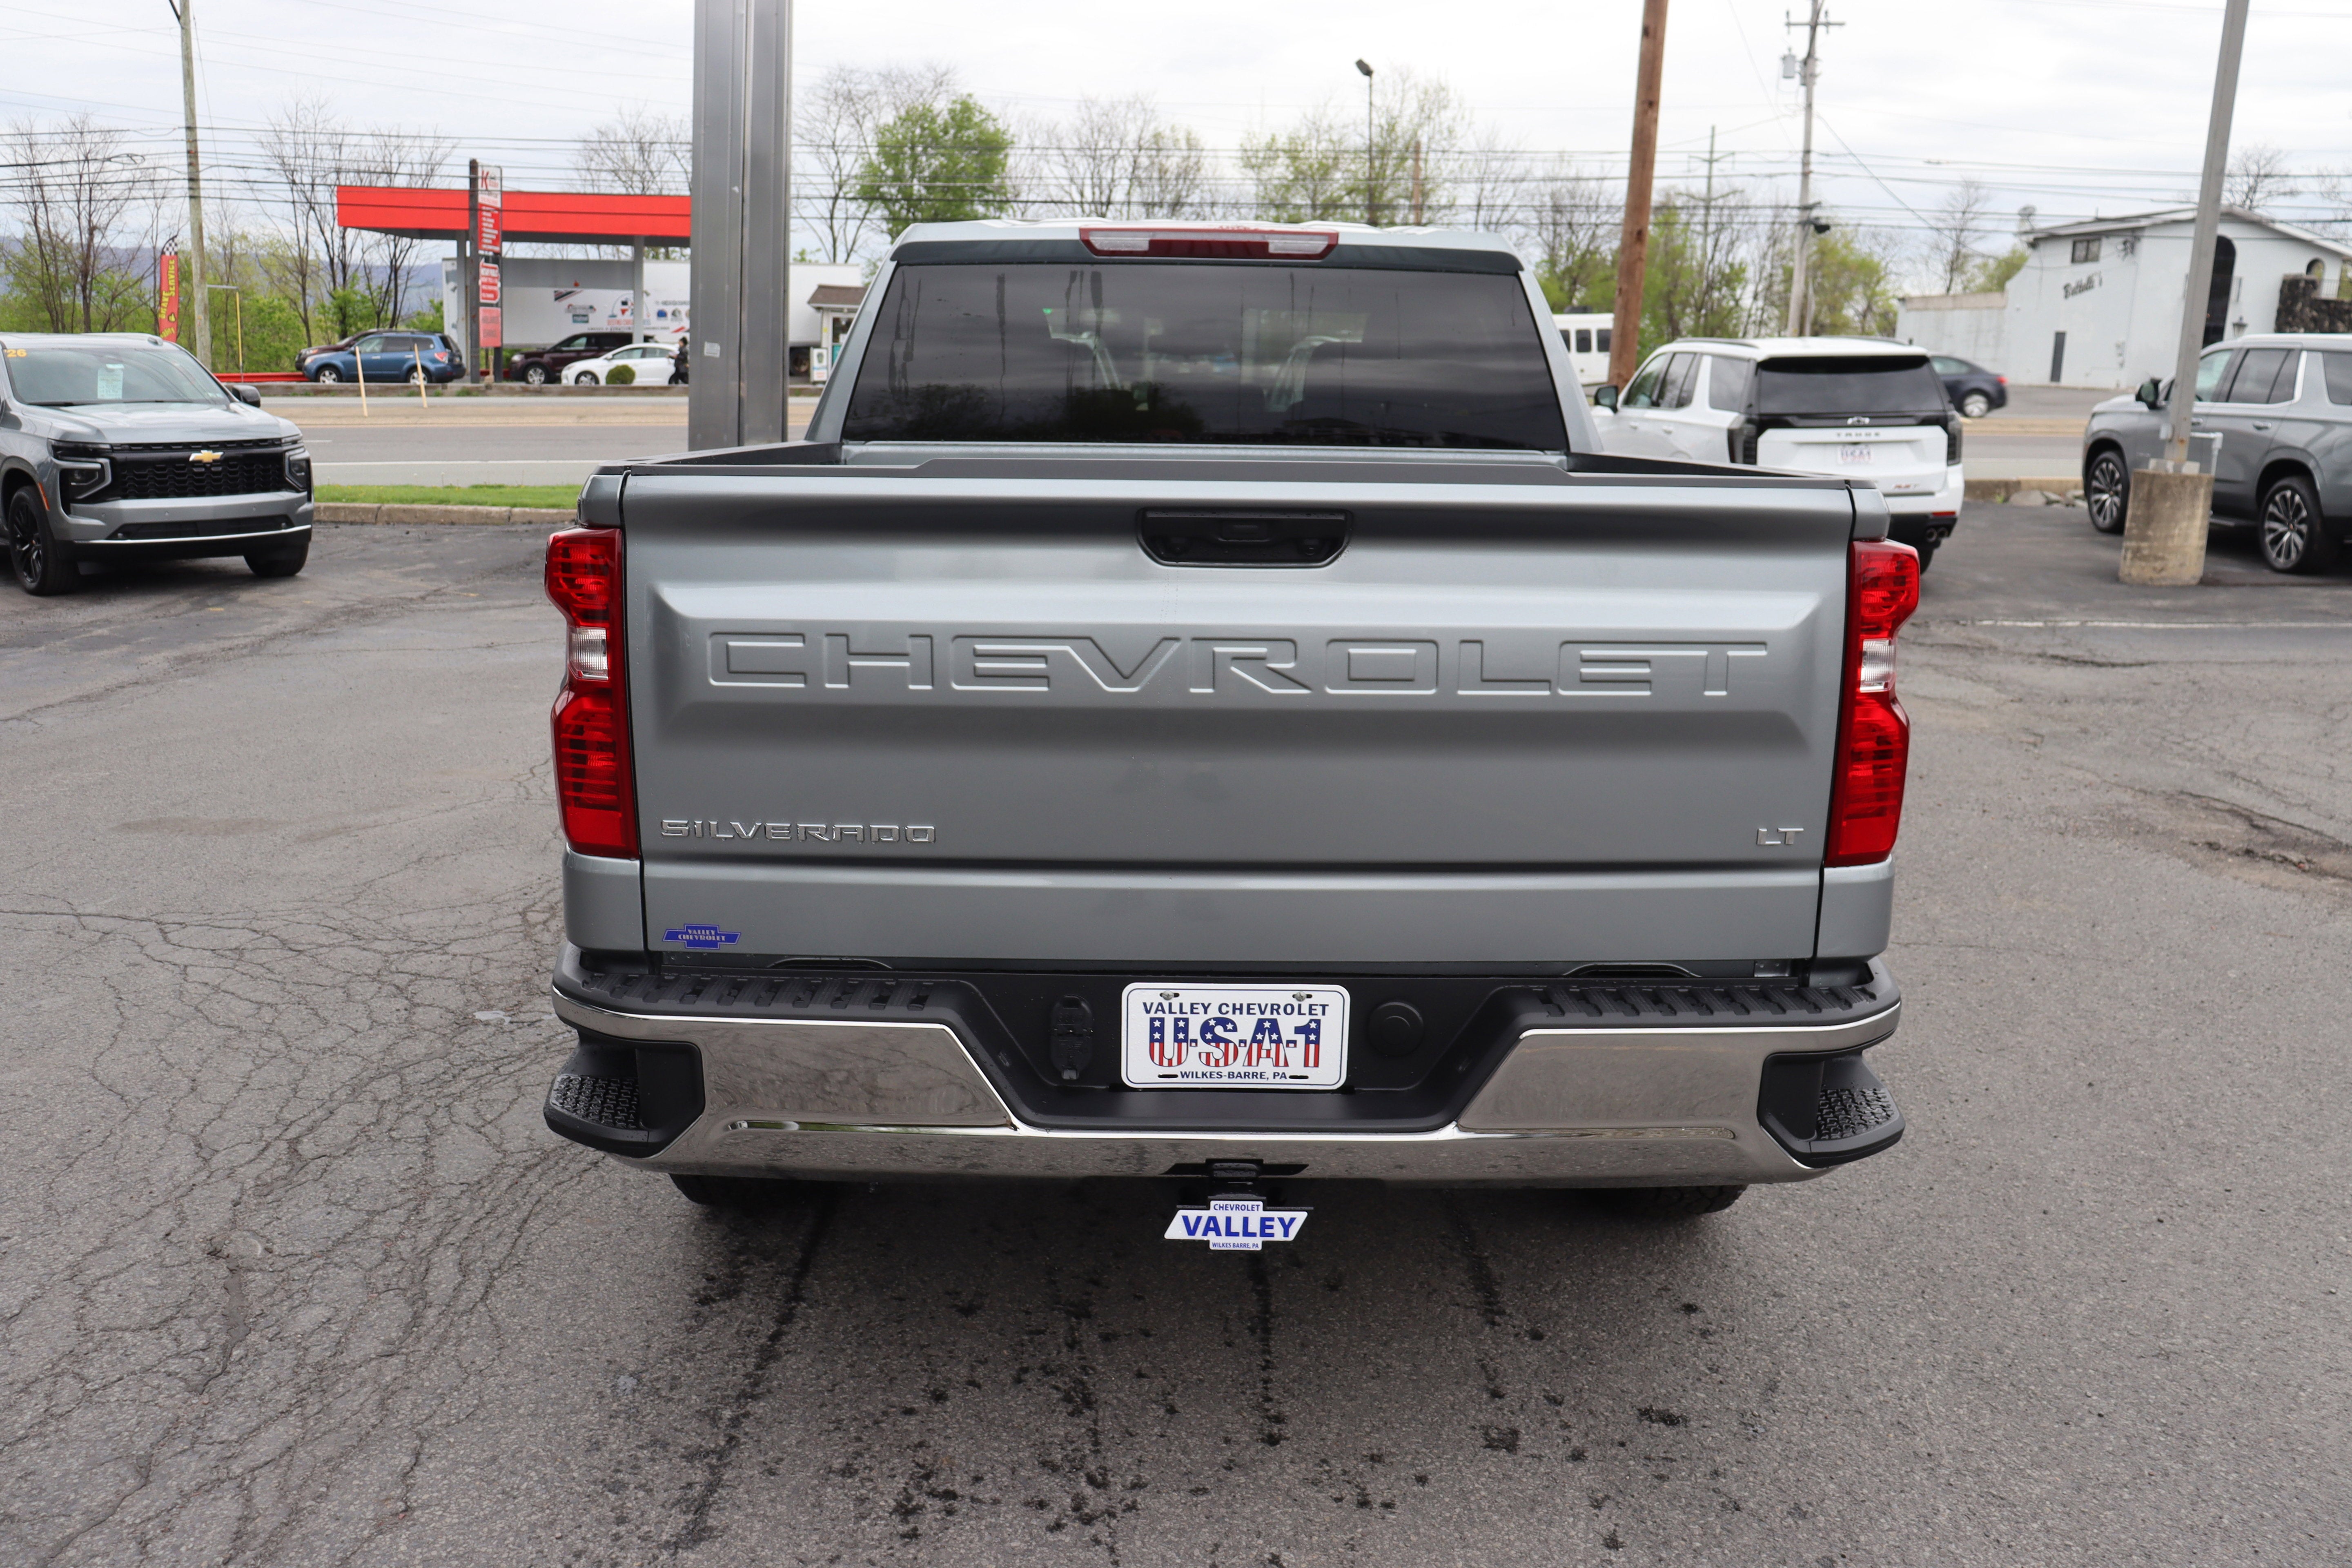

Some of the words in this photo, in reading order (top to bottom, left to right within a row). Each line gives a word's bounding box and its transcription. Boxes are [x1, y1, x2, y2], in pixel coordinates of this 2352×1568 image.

[159, 290, 171, 319] BRAKE
[707, 632, 1768, 696] CHEVROLET
[661, 819, 936, 844] SILVERADO
[1757, 827, 1804, 845] LT
[1143, 1002, 1212, 1015] VALLEY
[1218, 1003, 1329, 1016] CHEVROLET
[1180, 1071, 1269, 1081] WILKES-BARRE,
[1181, 1215, 1297, 1238] VALLEY
